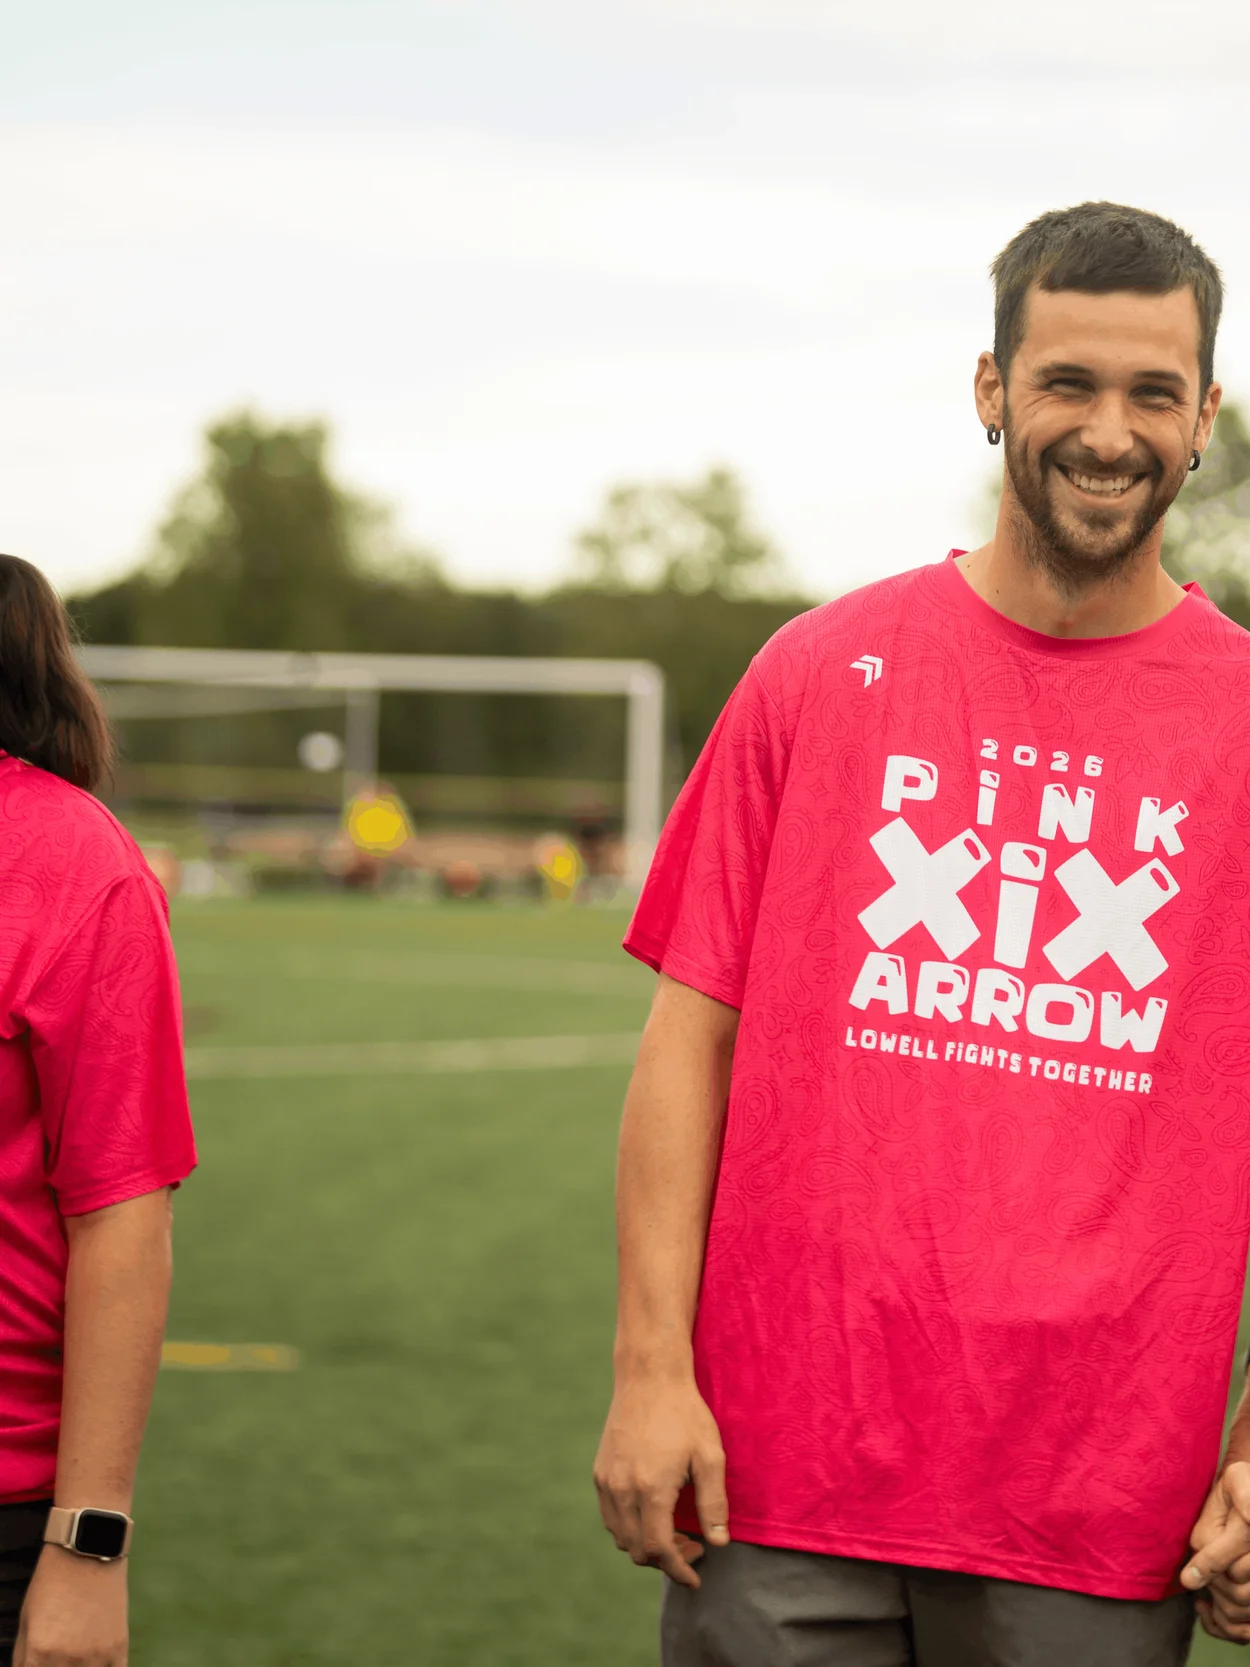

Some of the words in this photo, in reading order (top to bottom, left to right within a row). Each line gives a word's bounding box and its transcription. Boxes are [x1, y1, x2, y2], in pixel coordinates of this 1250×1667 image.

[979, 738, 1104, 777] 2026
[848, 951, 1169, 1053] ARROW
[845, 1026, 939, 1061] LOWELL
[1028, 1056, 1154, 1095] TOGETHER
